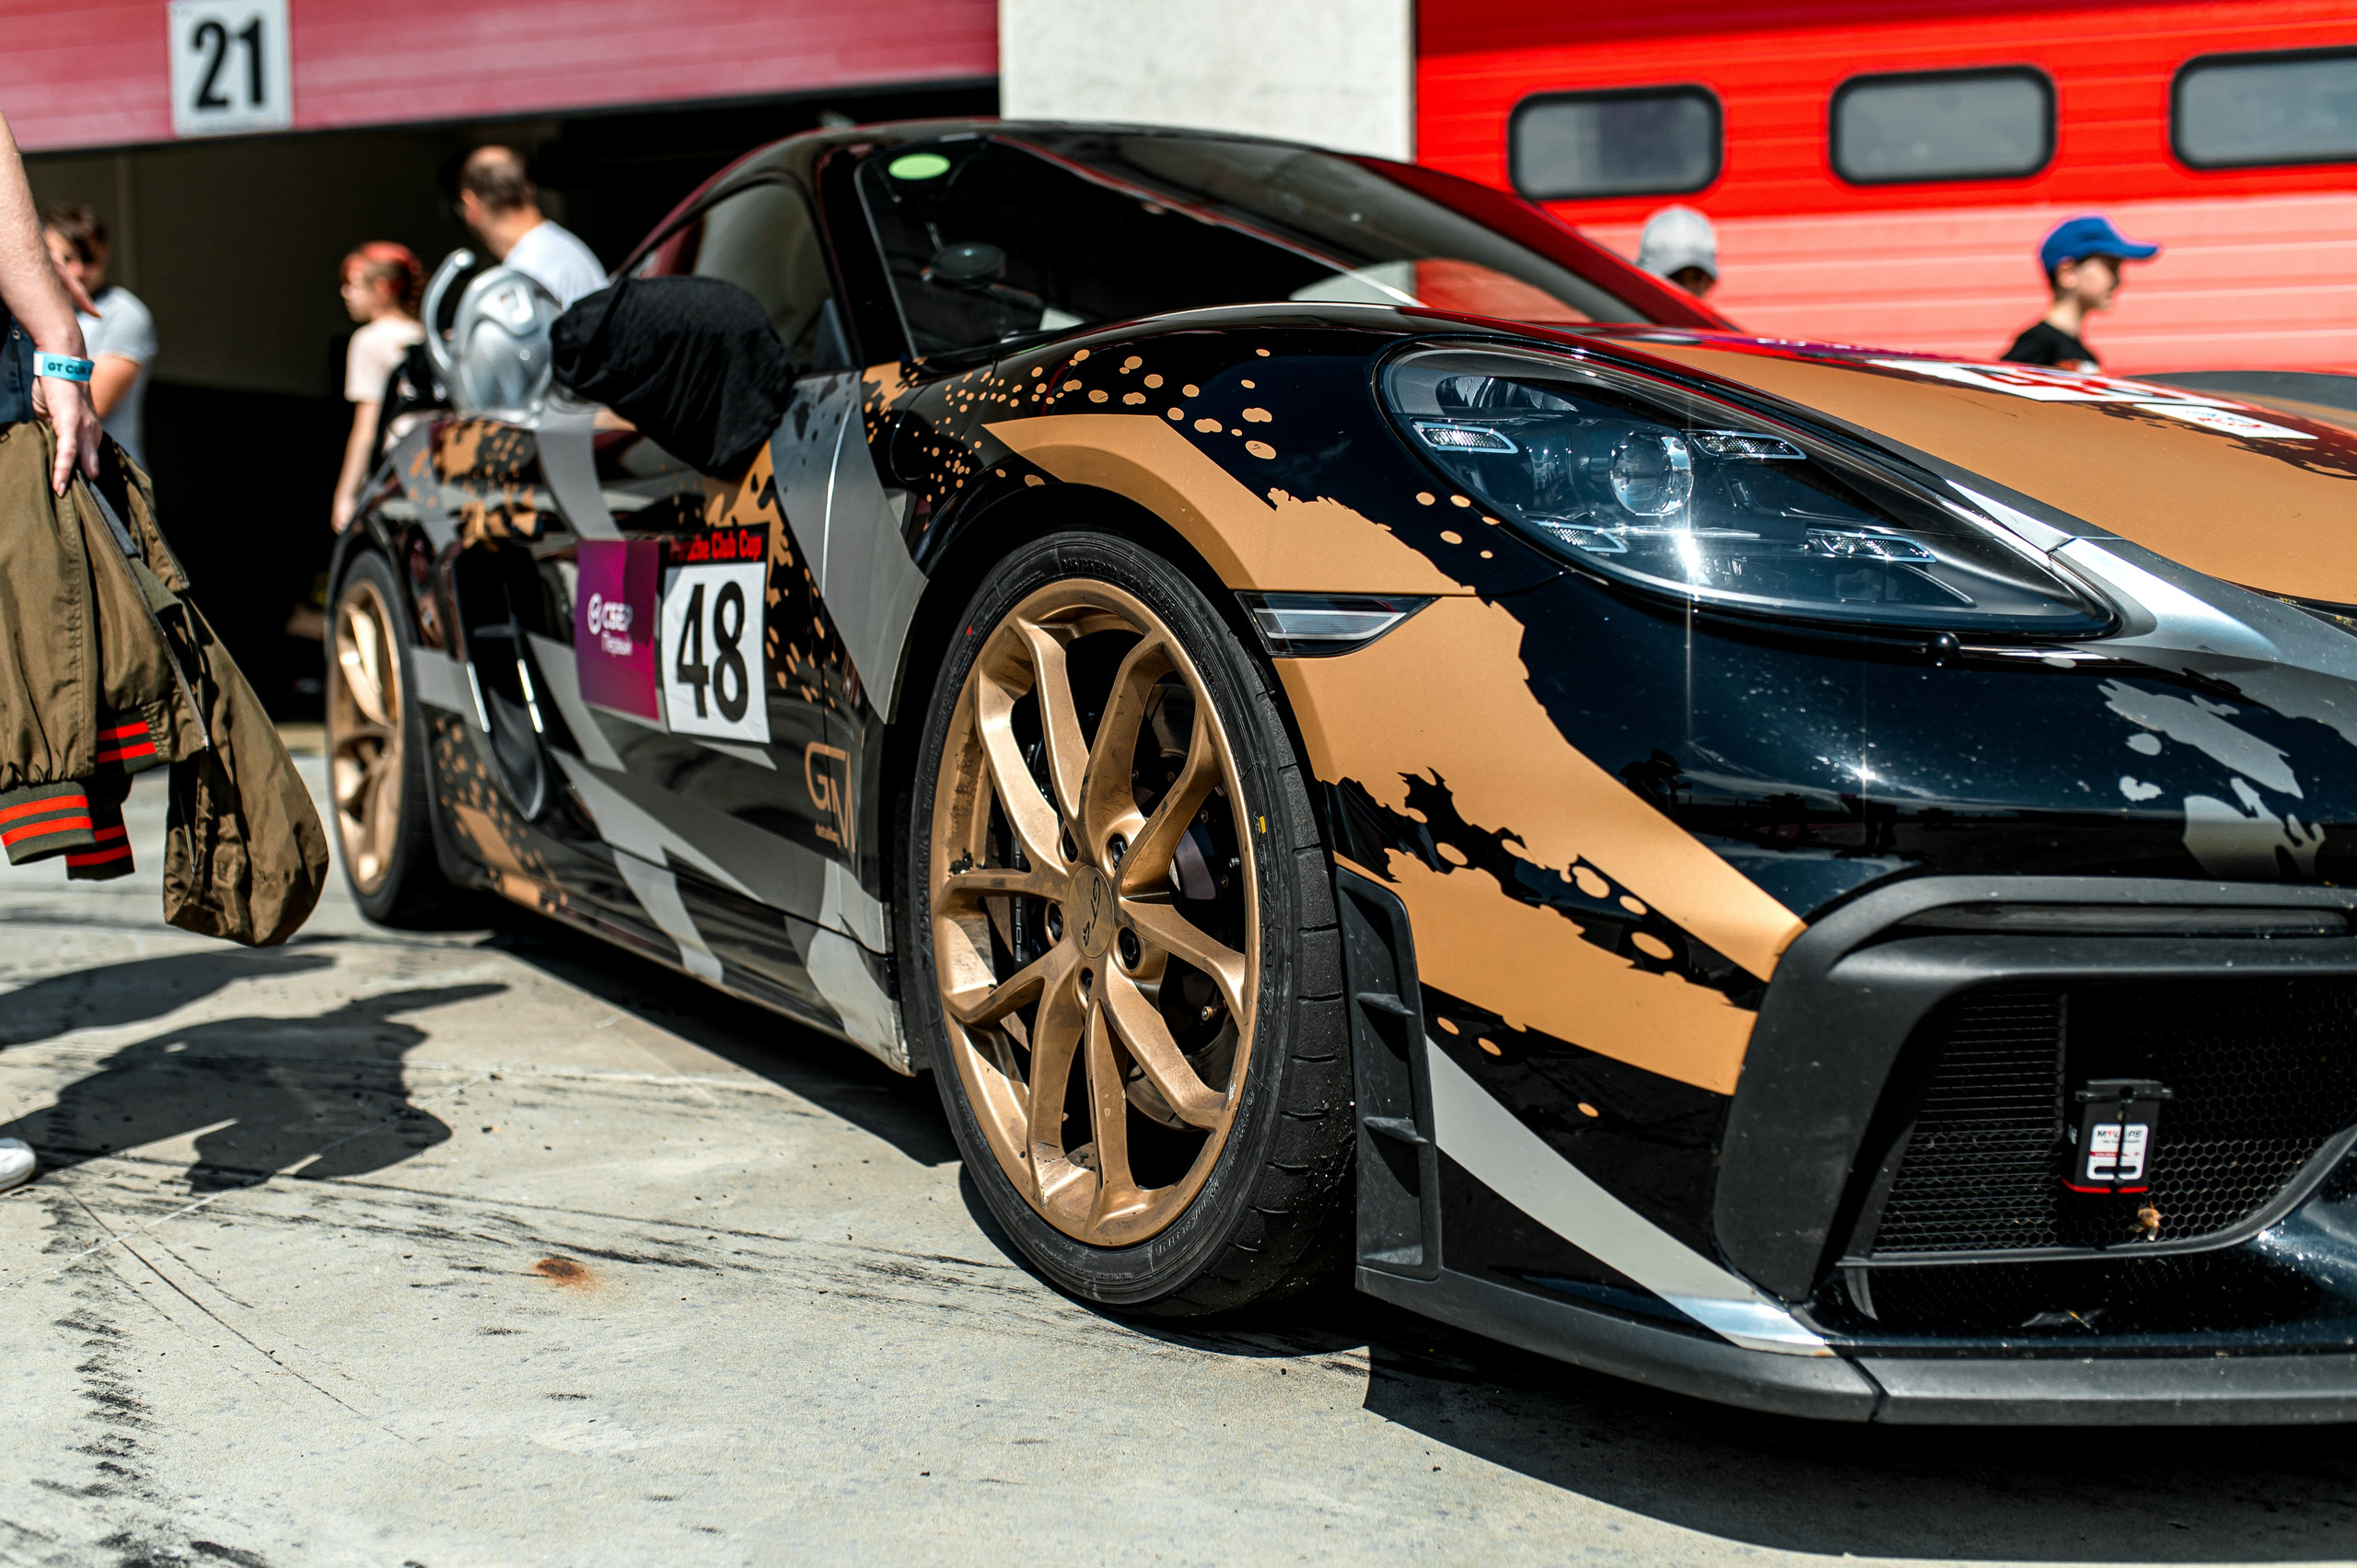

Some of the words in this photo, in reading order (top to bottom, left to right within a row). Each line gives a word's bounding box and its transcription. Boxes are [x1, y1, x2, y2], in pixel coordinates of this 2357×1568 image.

[192, 17, 263, 109] 21
[48, 361, 64, 372] GT
[712, 530, 737, 560] Club
[738, 528, 762, 562] Cup
[677, 580, 749, 723] 48
[2097, 1130, 2142, 1138] MYLPS
